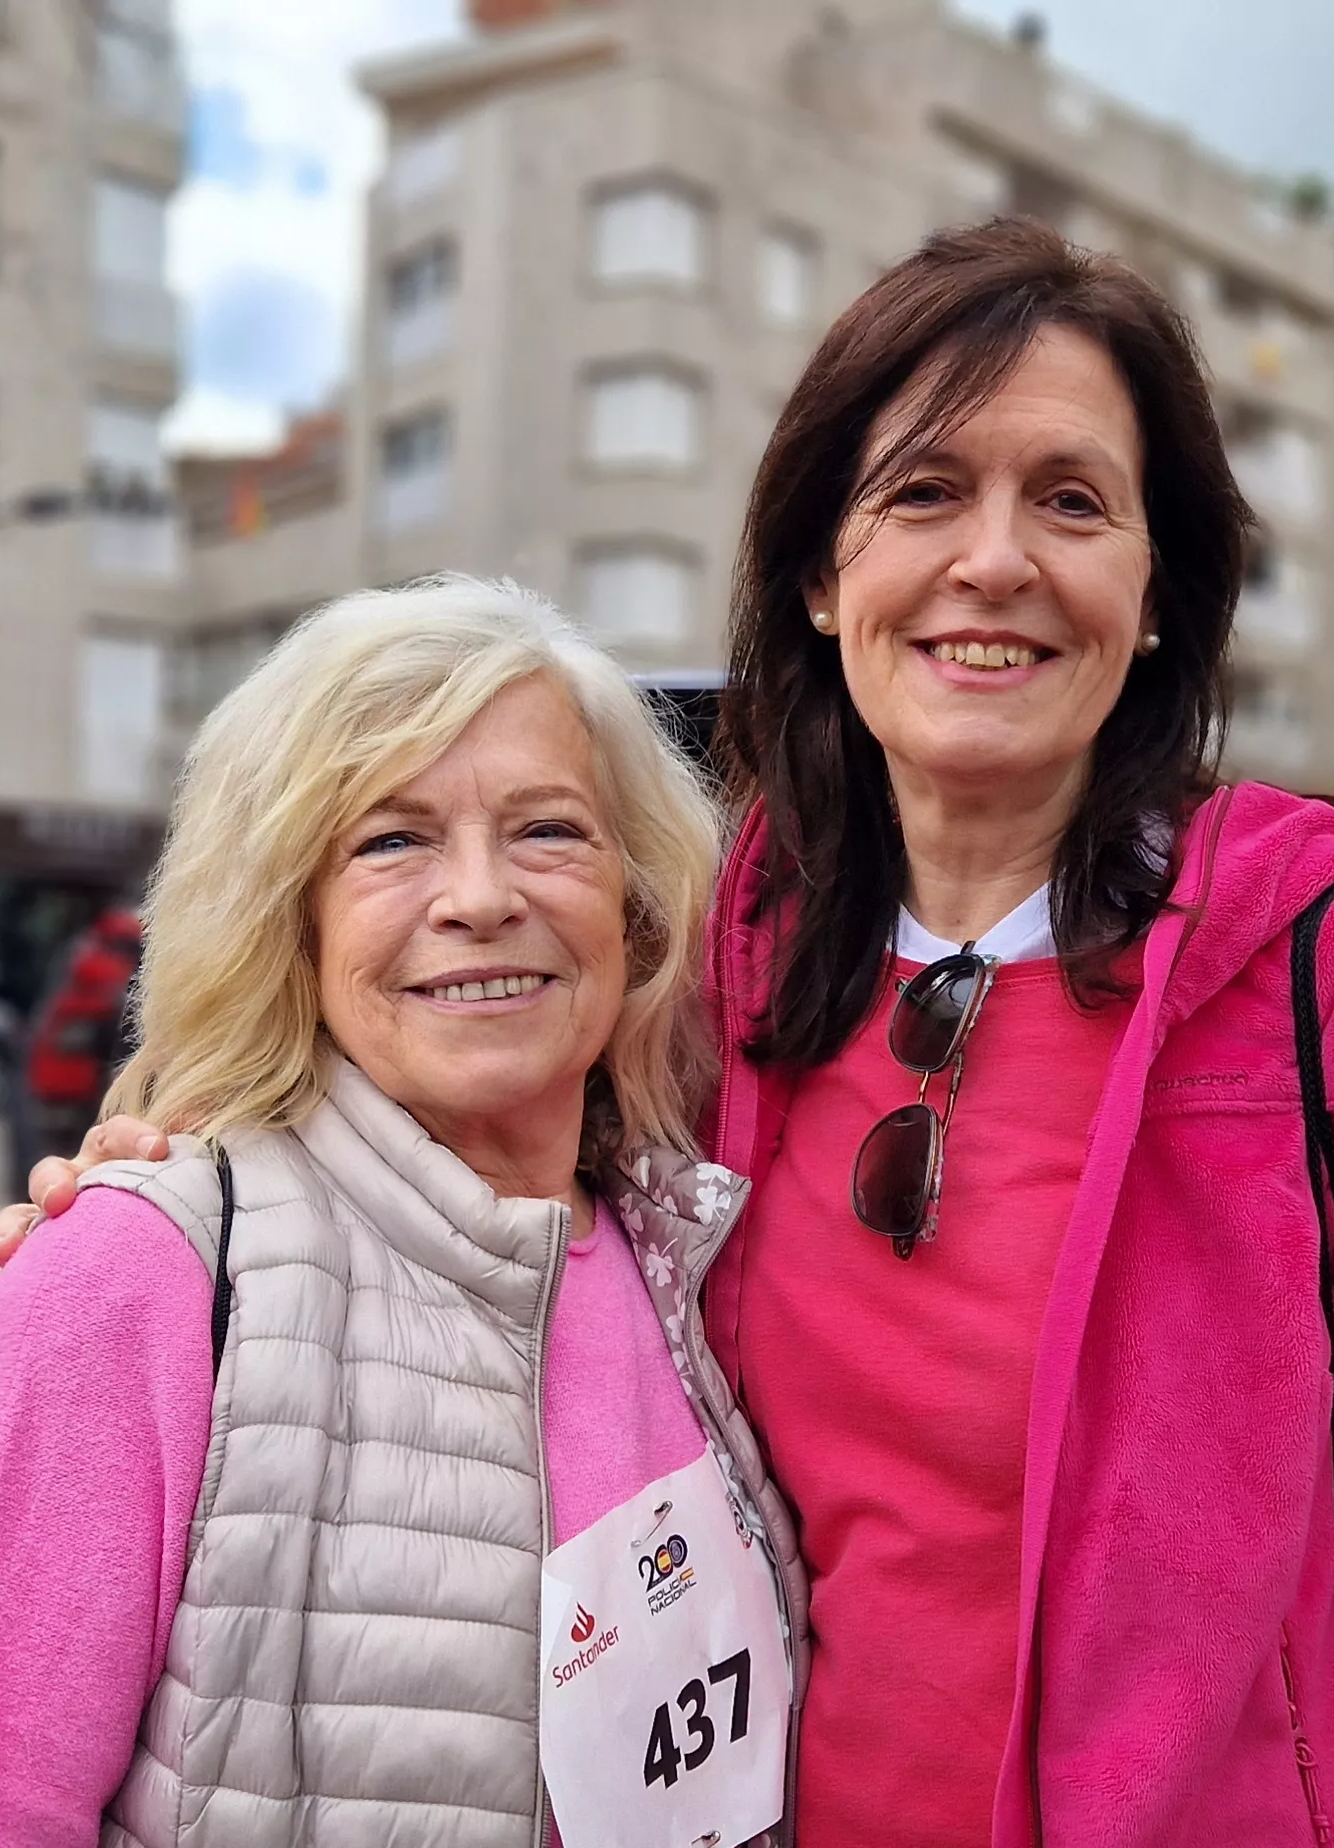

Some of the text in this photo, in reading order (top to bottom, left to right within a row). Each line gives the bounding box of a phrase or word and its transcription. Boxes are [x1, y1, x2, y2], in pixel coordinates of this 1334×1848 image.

[638, 1534, 688, 1593] 200
[650, 1579, 697, 1617] NACIONAL
[552, 1626, 619, 1688] Santander
[644, 1647, 751, 1790] 437
